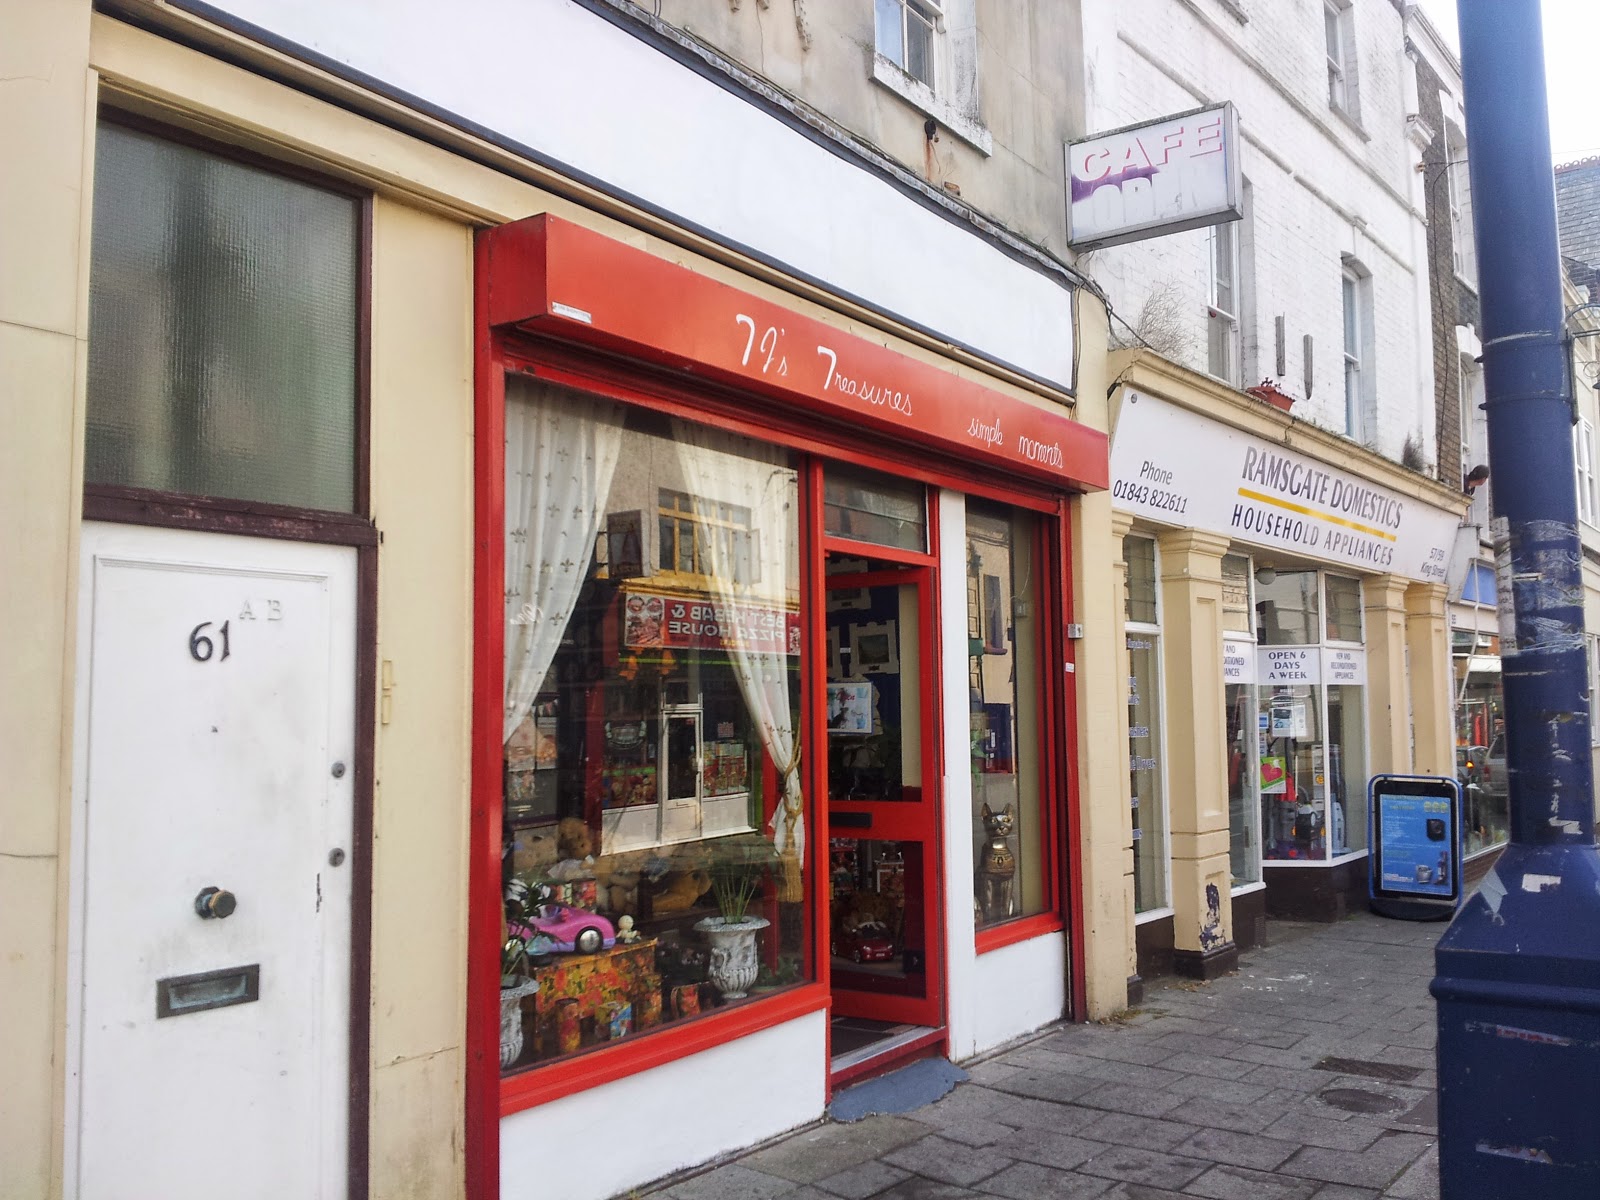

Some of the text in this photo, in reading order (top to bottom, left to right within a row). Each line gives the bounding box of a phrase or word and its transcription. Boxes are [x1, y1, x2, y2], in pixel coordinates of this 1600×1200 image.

[1084, 117, 1223, 182] CAFE
[967, 418, 1003, 448] simple
[1139, 460, 1173, 485] Phone
[1241, 446, 1403, 529] RAMSGATE DOMESTICS
[1113, 479, 1188, 514] 01843 822611
[1231, 503, 1394, 566] HOUSEHOLD APPLIANCES
[189, 619, 230, 662] 61
[1226, 645, 1236, 654] AND
[1268, 651, 1306, 660] OPEN 6
[1268, 671, 1308, 680] A WEEK
[1274, 661, 1301, 670] DAYS
